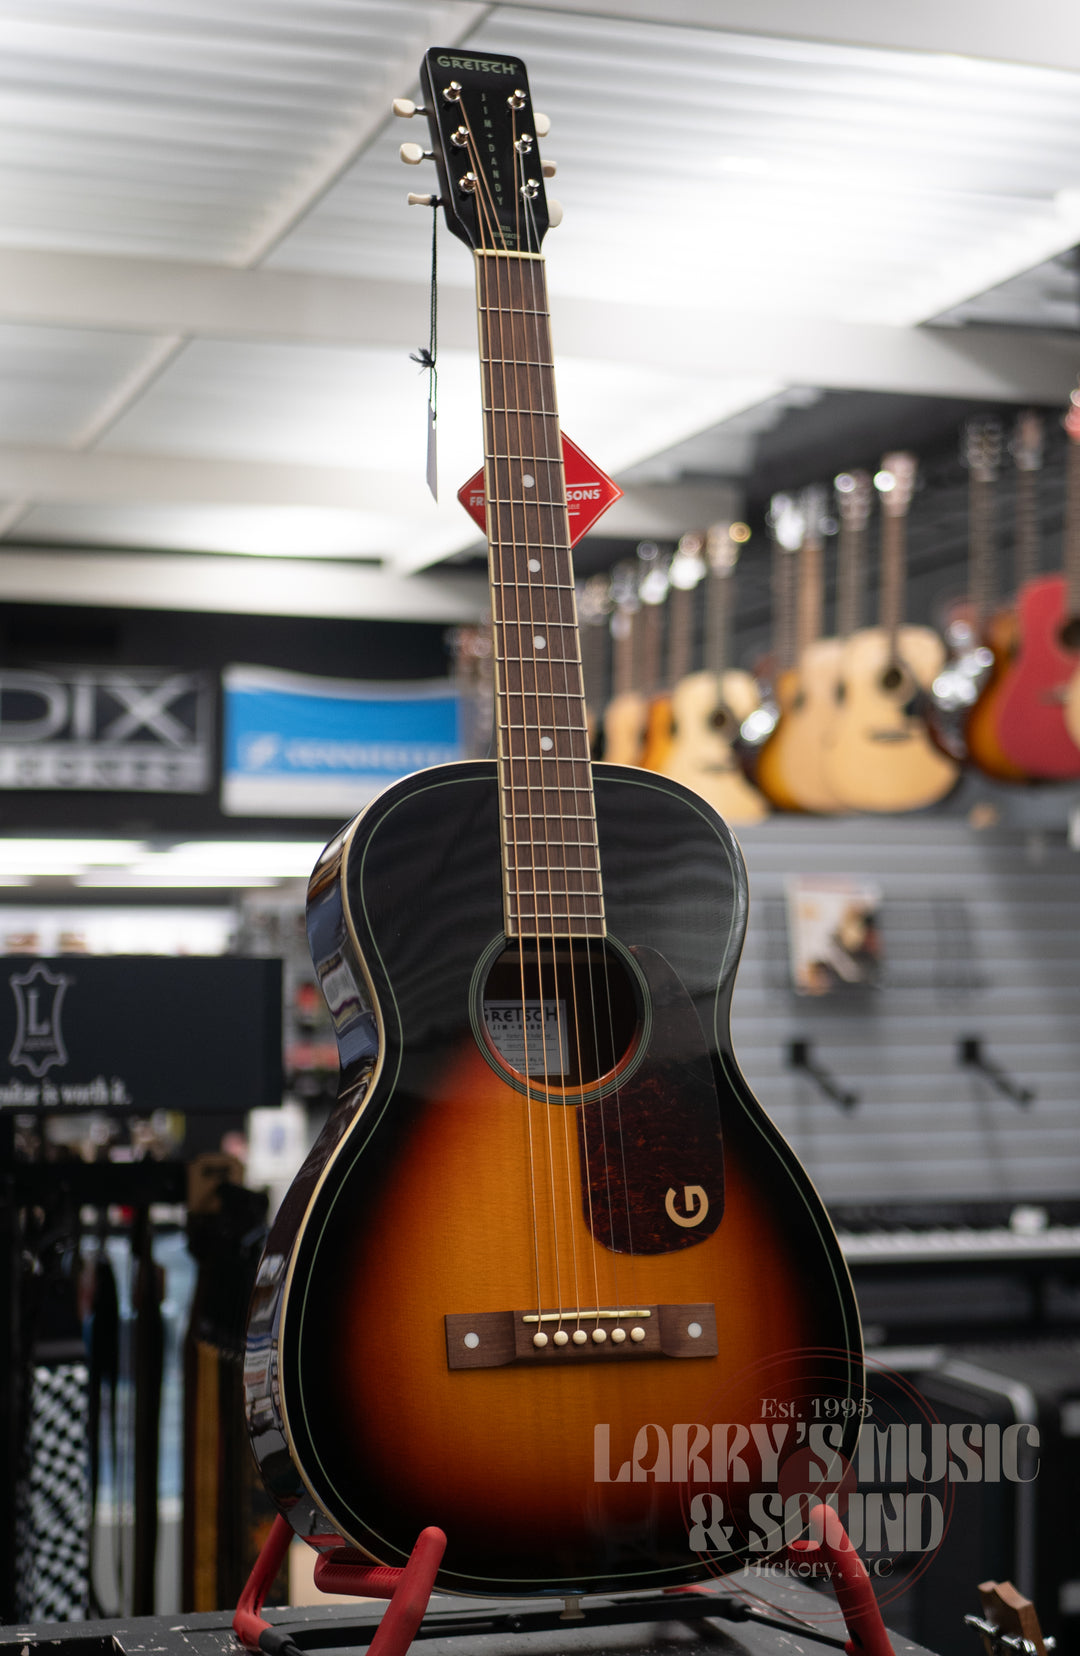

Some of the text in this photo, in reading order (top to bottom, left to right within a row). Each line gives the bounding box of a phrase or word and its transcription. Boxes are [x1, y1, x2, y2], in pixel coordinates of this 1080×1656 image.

[437, 55, 516, 75] GRETSCH
[470, 489, 601, 507] FR SONS
[664, 1184, 709, 1228] G
